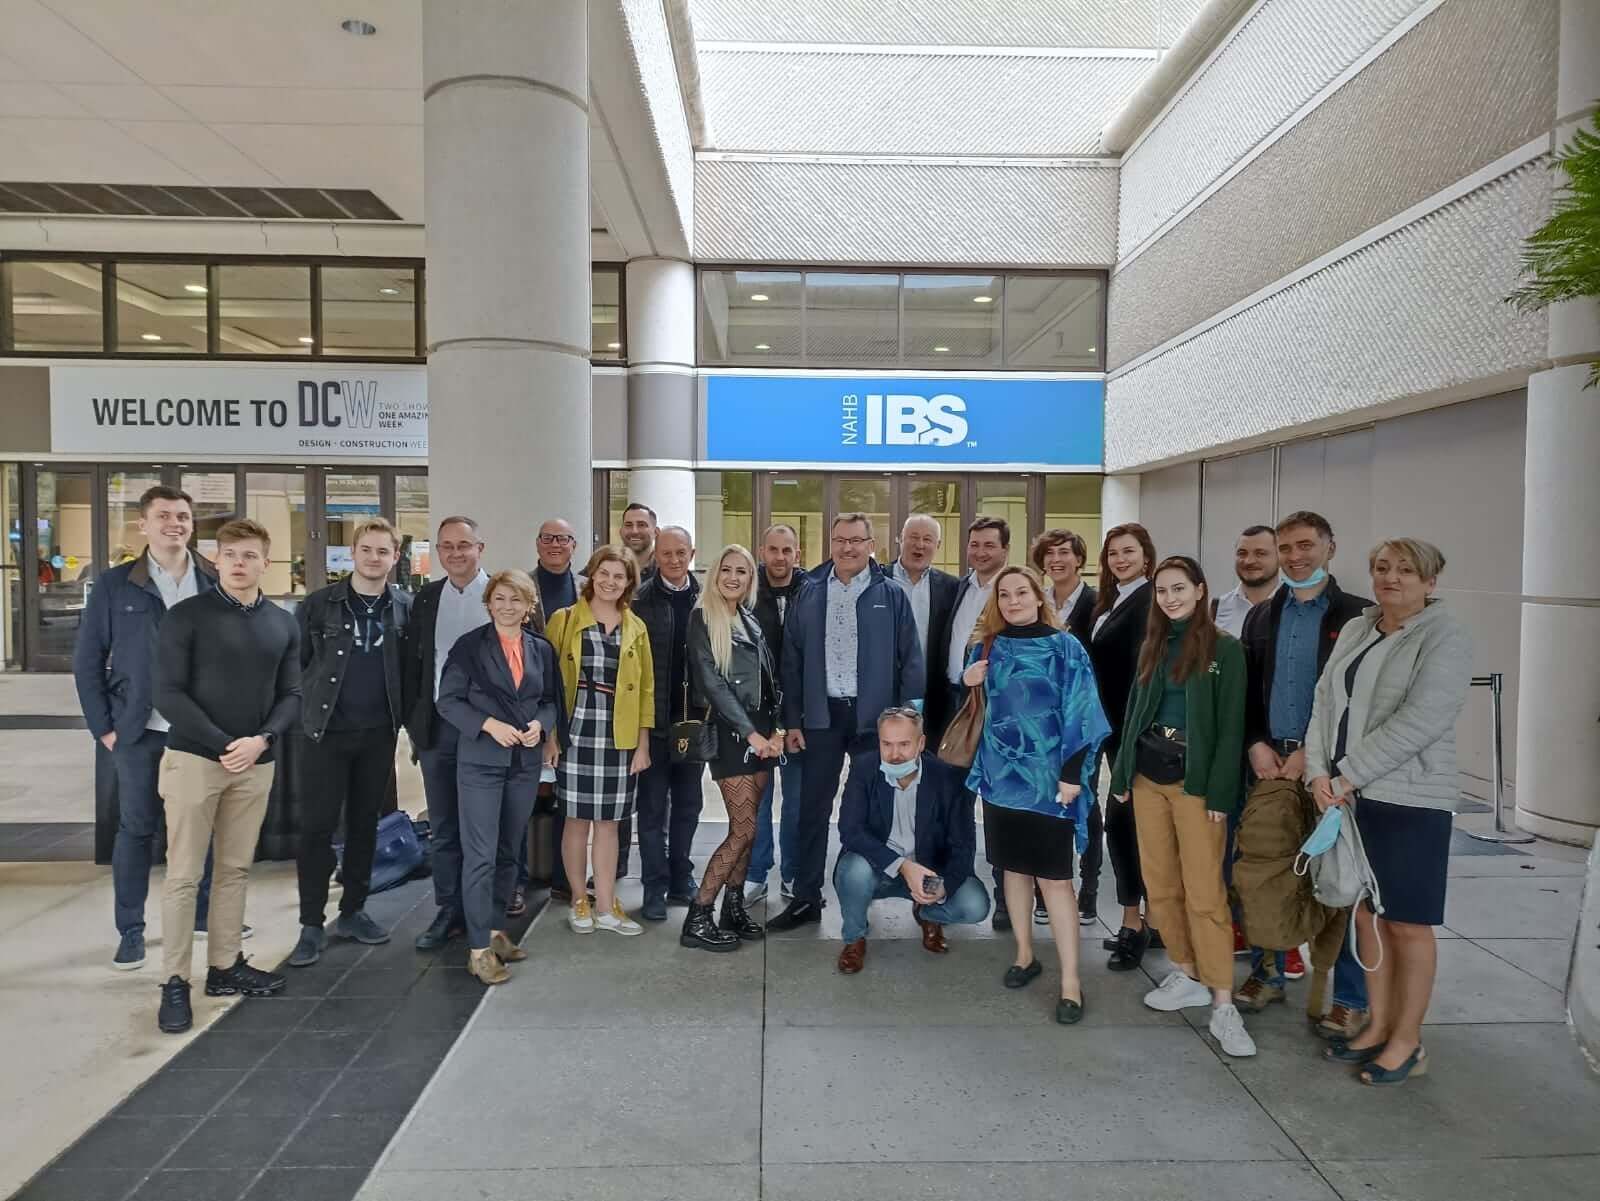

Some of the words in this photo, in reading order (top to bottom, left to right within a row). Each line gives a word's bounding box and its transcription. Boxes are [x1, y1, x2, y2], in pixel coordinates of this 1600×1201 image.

[92, 397, 241, 427] WELCOME
[249, 399, 288, 428] TO
[297, 380, 378, 429] DCW
[378, 401, 400, 410] TWO
[378, 411, 396, 420] ONE
[841, 393, 859, 445] NAHB
[865, 393, 968, 447] IBS
[378, 420, 402, 429] WEEK
[298, 439, 331, 448] DESIGN
[339, 439, 408, 448] CONSTRUCTION
